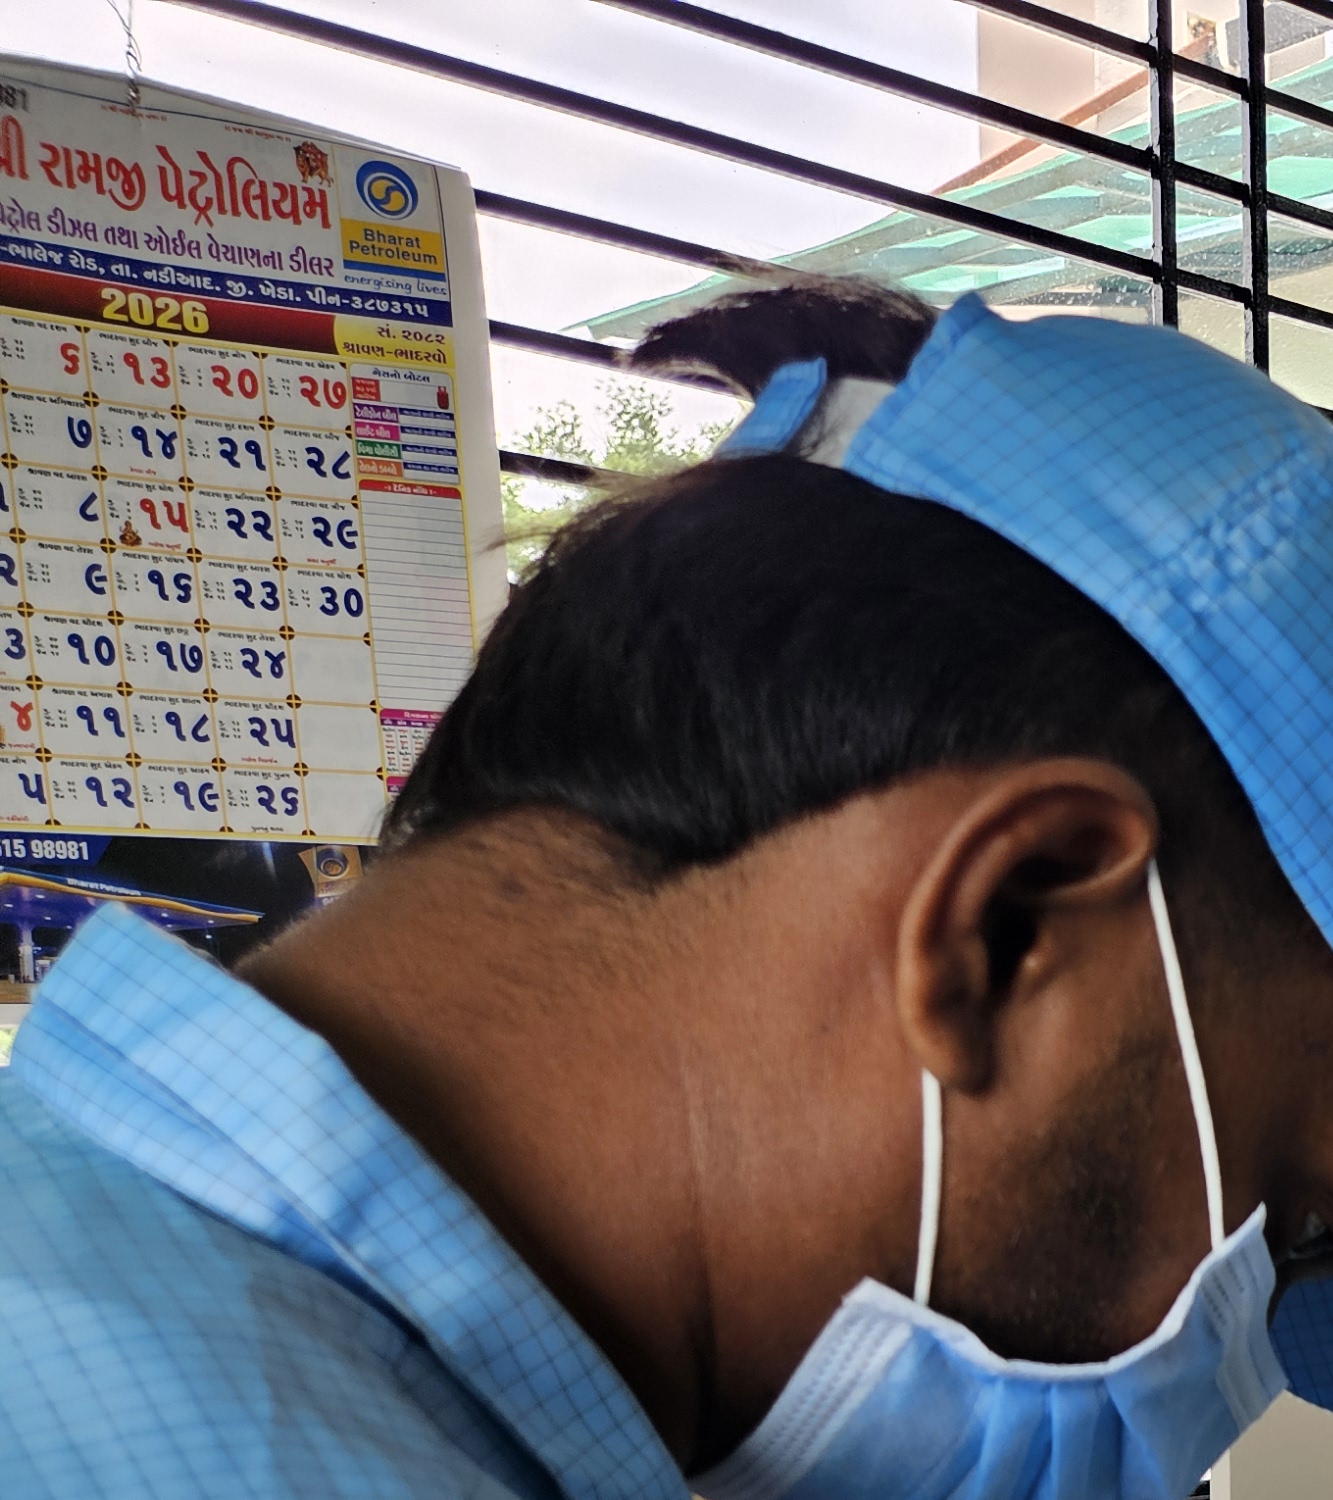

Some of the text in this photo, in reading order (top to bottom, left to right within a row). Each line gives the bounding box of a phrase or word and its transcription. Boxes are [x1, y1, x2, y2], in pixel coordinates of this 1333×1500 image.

[38, 141, 146, 212] રામજી
[155, 143, 332, 230] પેટ્રોલિયમ
[47, 207, 98, 242] ડીઝલ
[104, 225, 138, 251] તથા
[208, 233, 283, 271] વેચાણના
[289, 245, 335, 278] ડીલર
[349, 240, 438, 265] Petroleum
[363, 228, 421, 249] Bharat
[111, 262, 138, 279] તા.
[344, 274, 447, 296] energising lives
[100, 287, 210, 334] 2026
[401, 330, 445, 345] ૨૦૮૨
[60, 342, 80, 375] ૬
[123, 352, 171, 389] ૧૩
[210, 364, 259, 400] ૨૦
[298, 375, 347, 409] ૨૭
[67, 416, 92, 449] ૭
[131, 424, 178, 460] ૧૪
[217, 436, 266, 472] ૨૧
[305, 446, 351, 480] ૨૮
[78, 492, 99, 522] ૮
[139, 497, 189, 533] ૧૫
[225, 507, 274, 542] ૨૨
[311, 516, 358, 550] ૨૯
[84, 563, 108, 595] ૯
[147, 569, 192, 604] ૧૬
[232, 578, 281, 612] ૨૩
[319, 585, 364, 618] ૩૦
[4, 628, 26, 660] ૩
[67, 632, 116, 667] ૧૦
[156, 640, 203, 674] ૧૭
[239, 647, 287, 679] ૨૪
[9, 700, 34, 732] ૪
[75, 705, 125, 738] ૧૧
[165, 711, 210, 742] ૧૮
[247, 716, 296, 749] ૨૫
[17, 773, 47, 805] ૫
[85, 775, 135, 809] ૧૨
[173, 780, 220, 813] ૧૯
[255, 784, 299, 817] ૨૬
[0, 839, 89, 861] 15 98981
